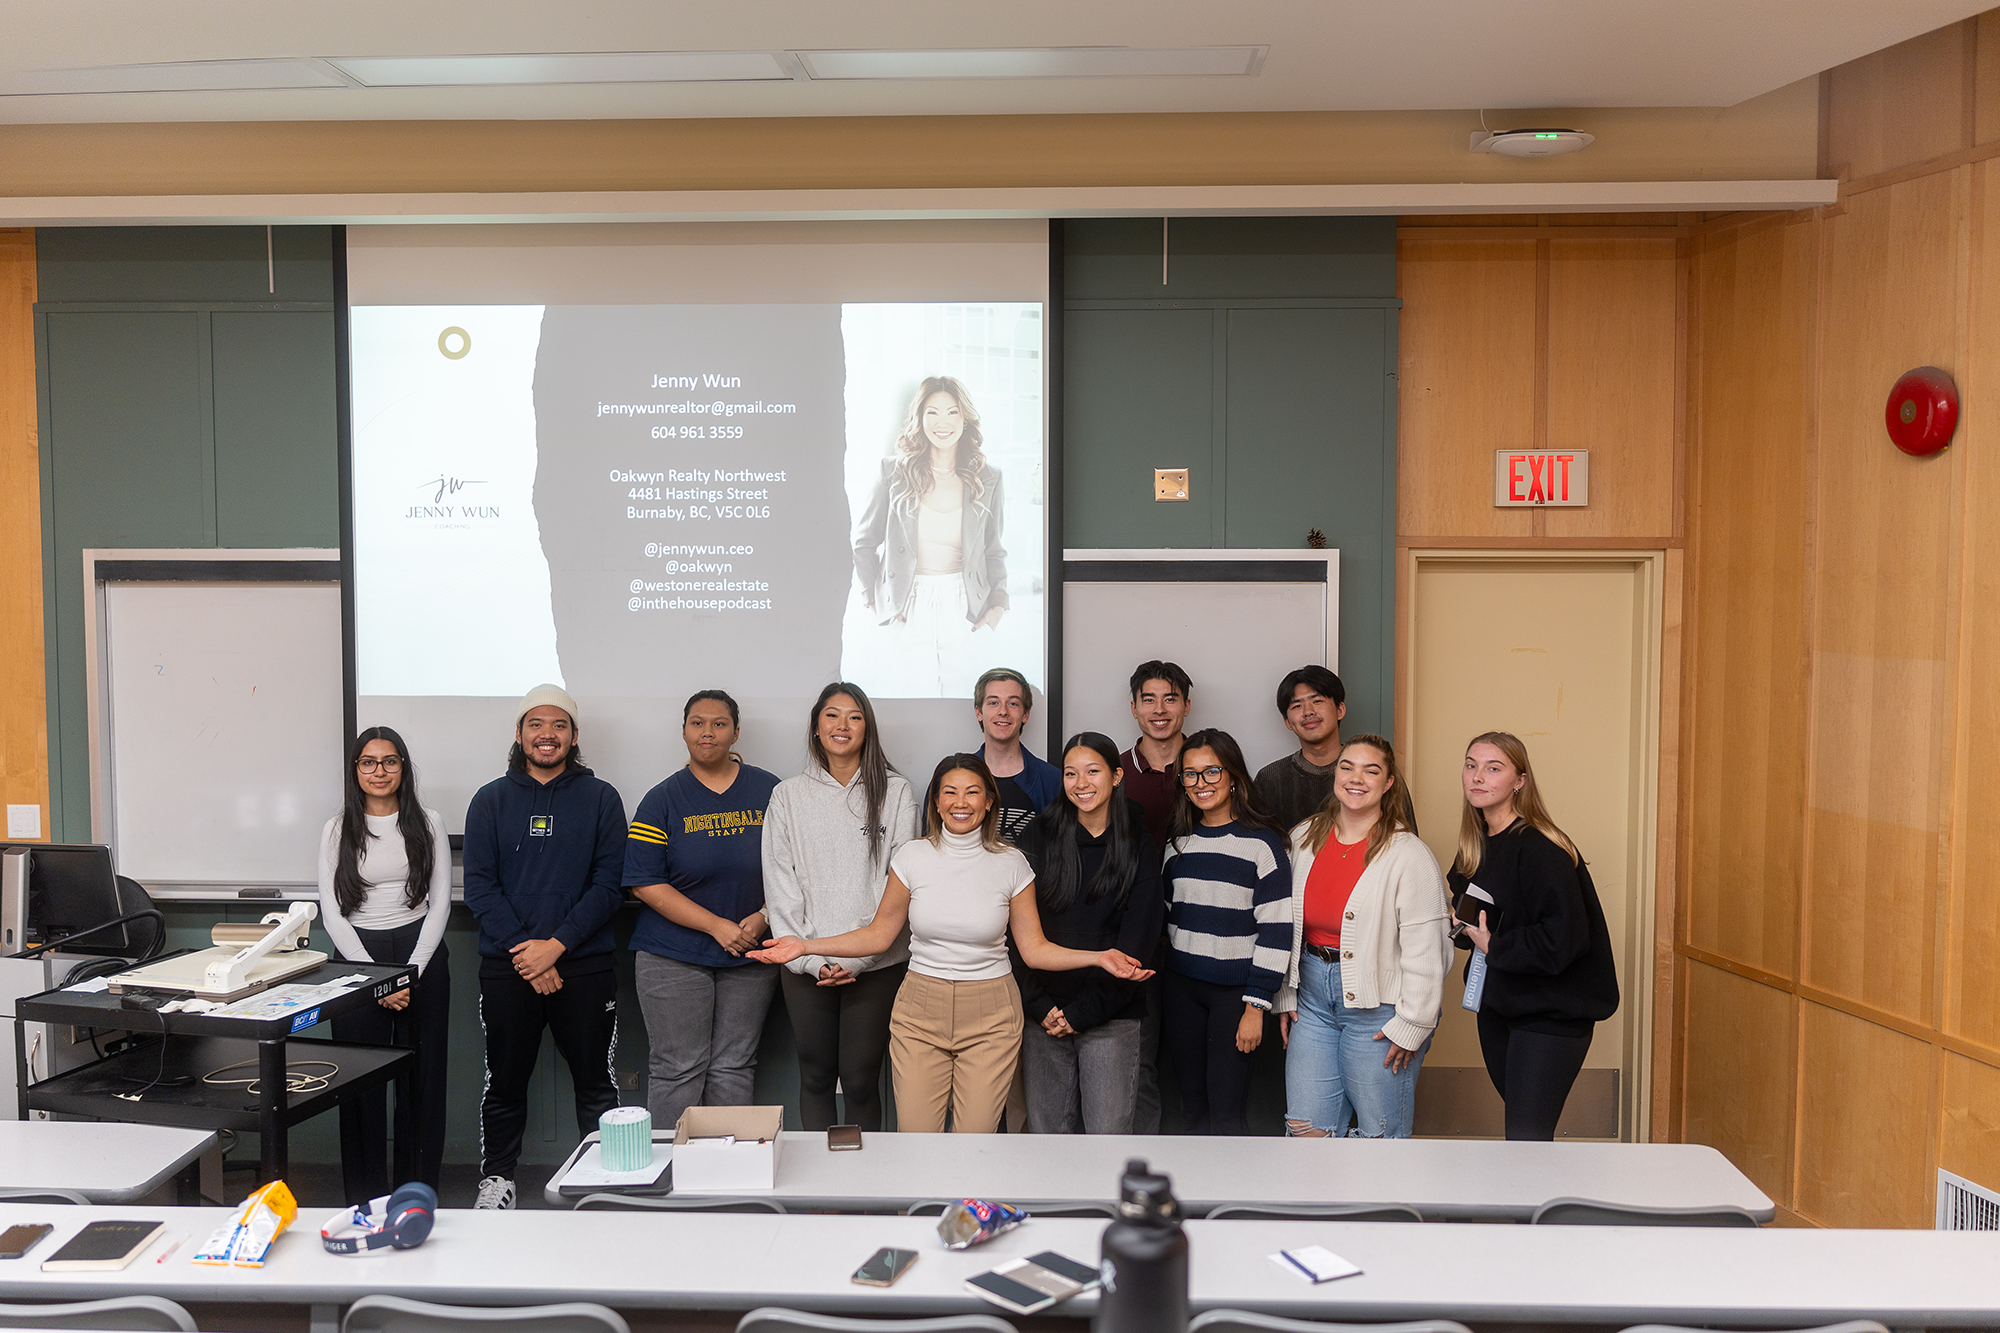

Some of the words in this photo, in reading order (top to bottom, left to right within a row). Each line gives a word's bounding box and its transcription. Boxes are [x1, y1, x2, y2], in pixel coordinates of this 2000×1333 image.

[651, 373, 699, 391] Jenny
[702, 373, 741, 388] Wun
[597, 400, 796, 417] jennywunrealtor@gmail.com
[651, 426, 676, 439] 604
[679, 426, 705, 439] 961
[709, 426, 744, 439] 3559
[609, 469, 664, 485] Oakwyn
[668, 469, 711, 485] Realty
[714, 469, 787, 482] Northwest
[1509, 455, 1574, 501] EXIT
[628, 487, 662, 500] 4481
[665, 487, 723, 503] Hastings
[726, 487, 768, 500] Street
[405, 506, 455, 519] JENNY
[462, 506, 500, 519] WUN
[626, 505, 686, 521] Burnaby,
[689, 505, 712, 521] BC,
[715, 505, 743, 518] V5C
[644, 542, 754, 558] @jennywun.ceo
[665, 559, 732, 576] @oakwyn
[629, 578, 769, 594] @westonerealestate
[628, 596, 772, 612] @inthehousepodcast
[683, 809, 764, 834] NIGHTINGALE
[708, 827, 746, 837] STAFF
[1465, 951, 1486, 1008] lululemon
[374, 981, 392, 998] 1201
[308, 1010, 319, 1021] AV
